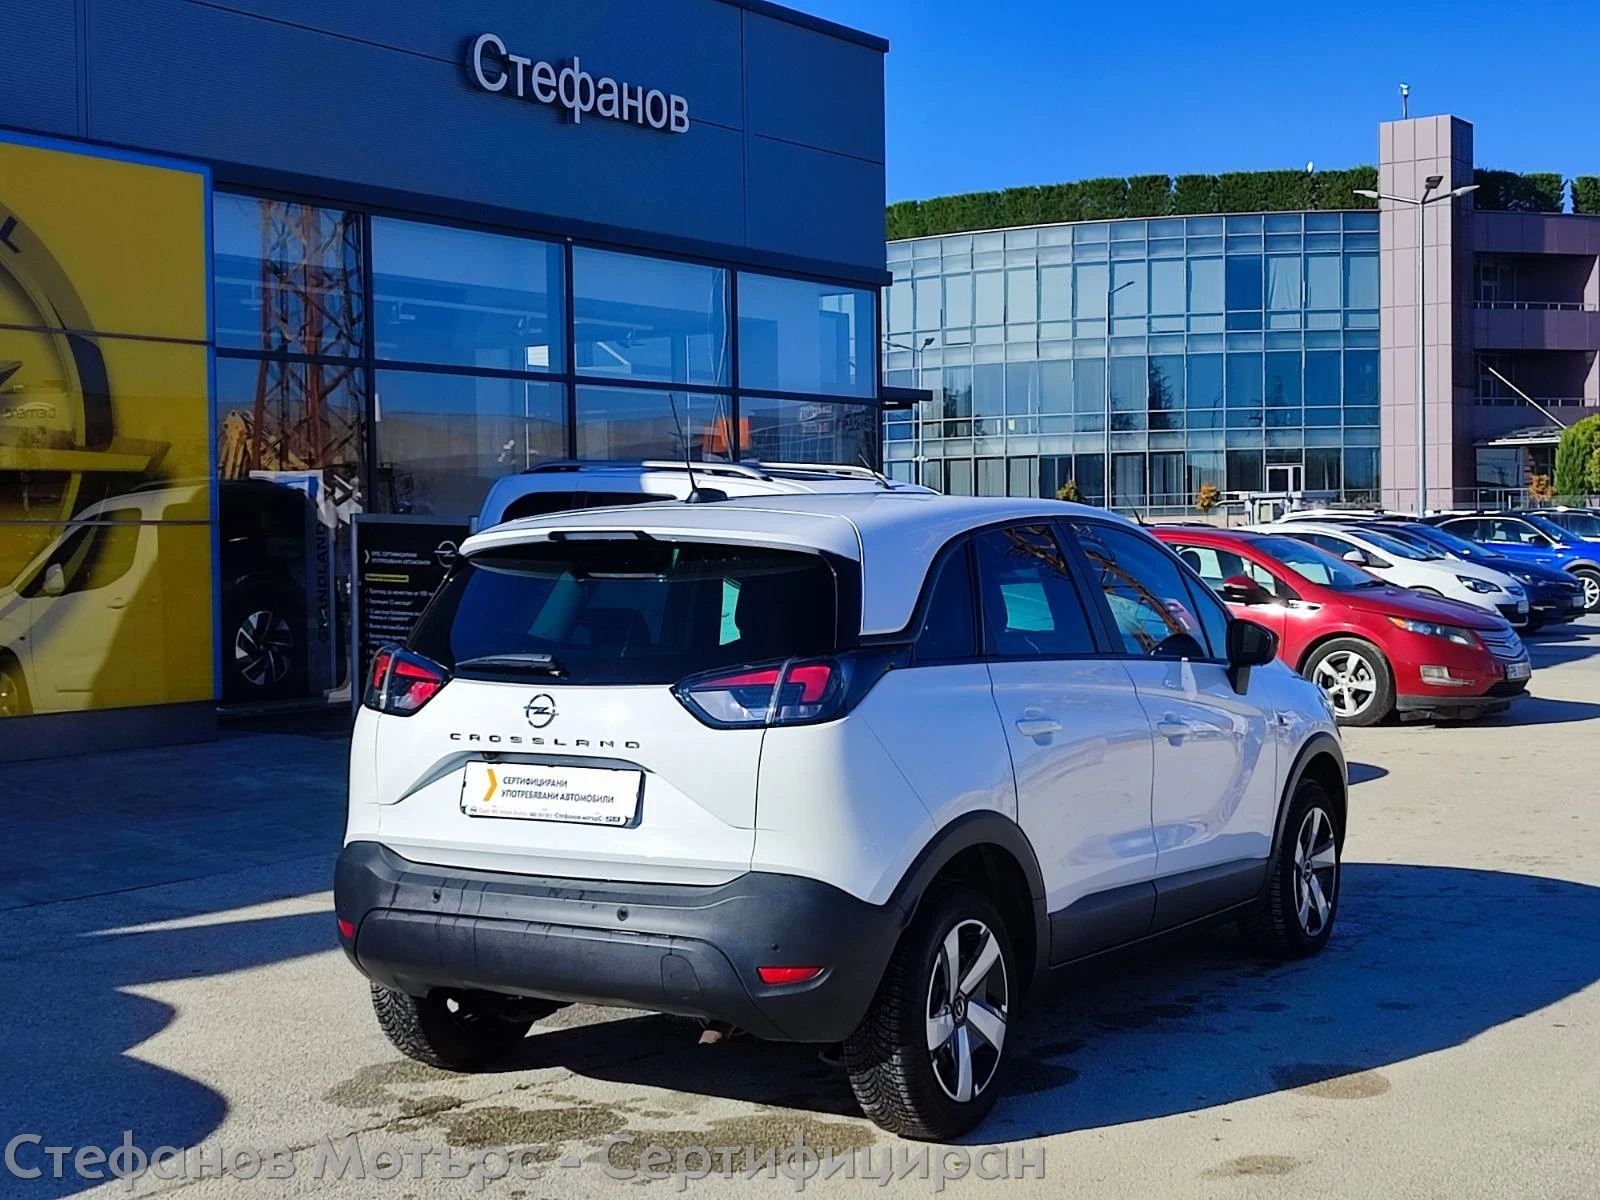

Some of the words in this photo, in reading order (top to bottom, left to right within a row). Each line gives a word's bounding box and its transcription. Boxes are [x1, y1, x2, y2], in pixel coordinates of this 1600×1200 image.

[473, 33, 690, 134] Стефанов
[450, 732, 641, 749] CROSSLAND
[502, 776, 568, 788] СЕРТИФИЦИРАНИ
[501, 788, 559, 800] УПОТРЕБЯВАНИ
[559, 792, 615, 804] АВТОМОБИЛИ
